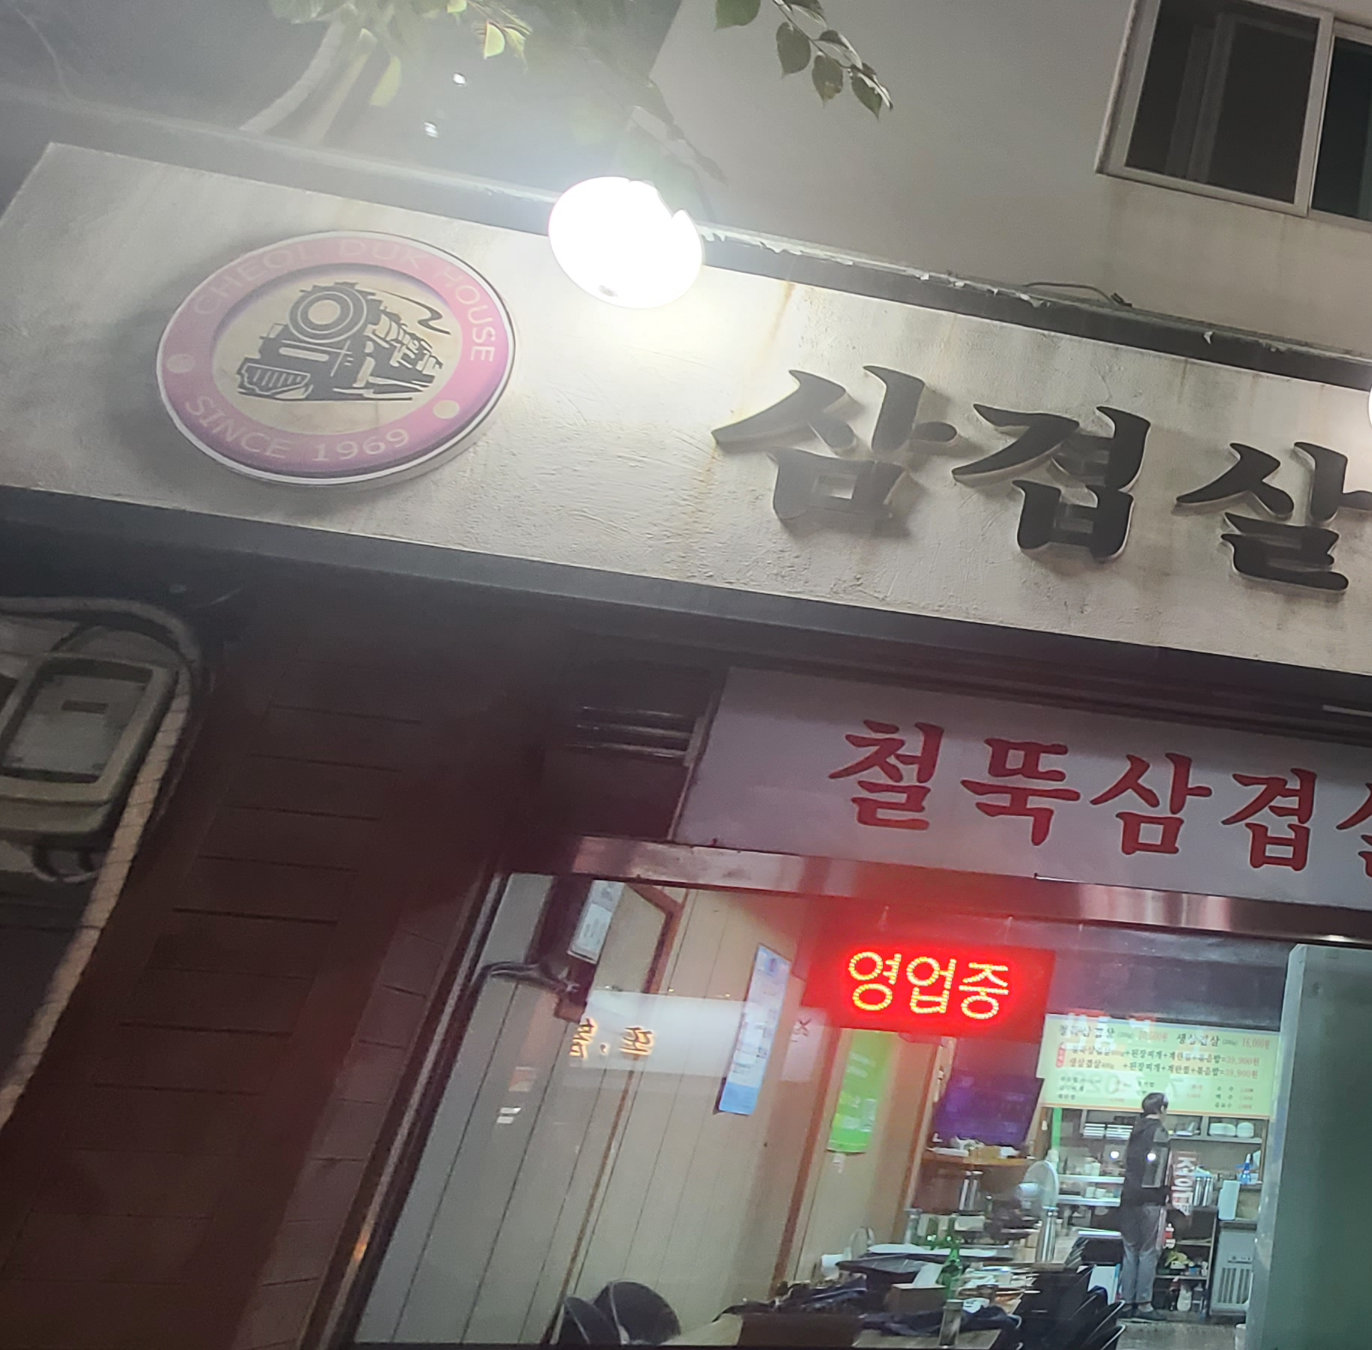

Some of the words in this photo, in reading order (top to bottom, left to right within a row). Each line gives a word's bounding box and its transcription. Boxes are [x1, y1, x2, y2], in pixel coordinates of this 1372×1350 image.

[194, 243, 309, 316] CHEOL
[338, 239, 430, 270] DUK
[433, 266, 497, 363] HOUSE
[184, 395, 295, 460] SINCE
[312, 428, 410, 462] 1969
[847, 949, 1011, 1021] 영업중
